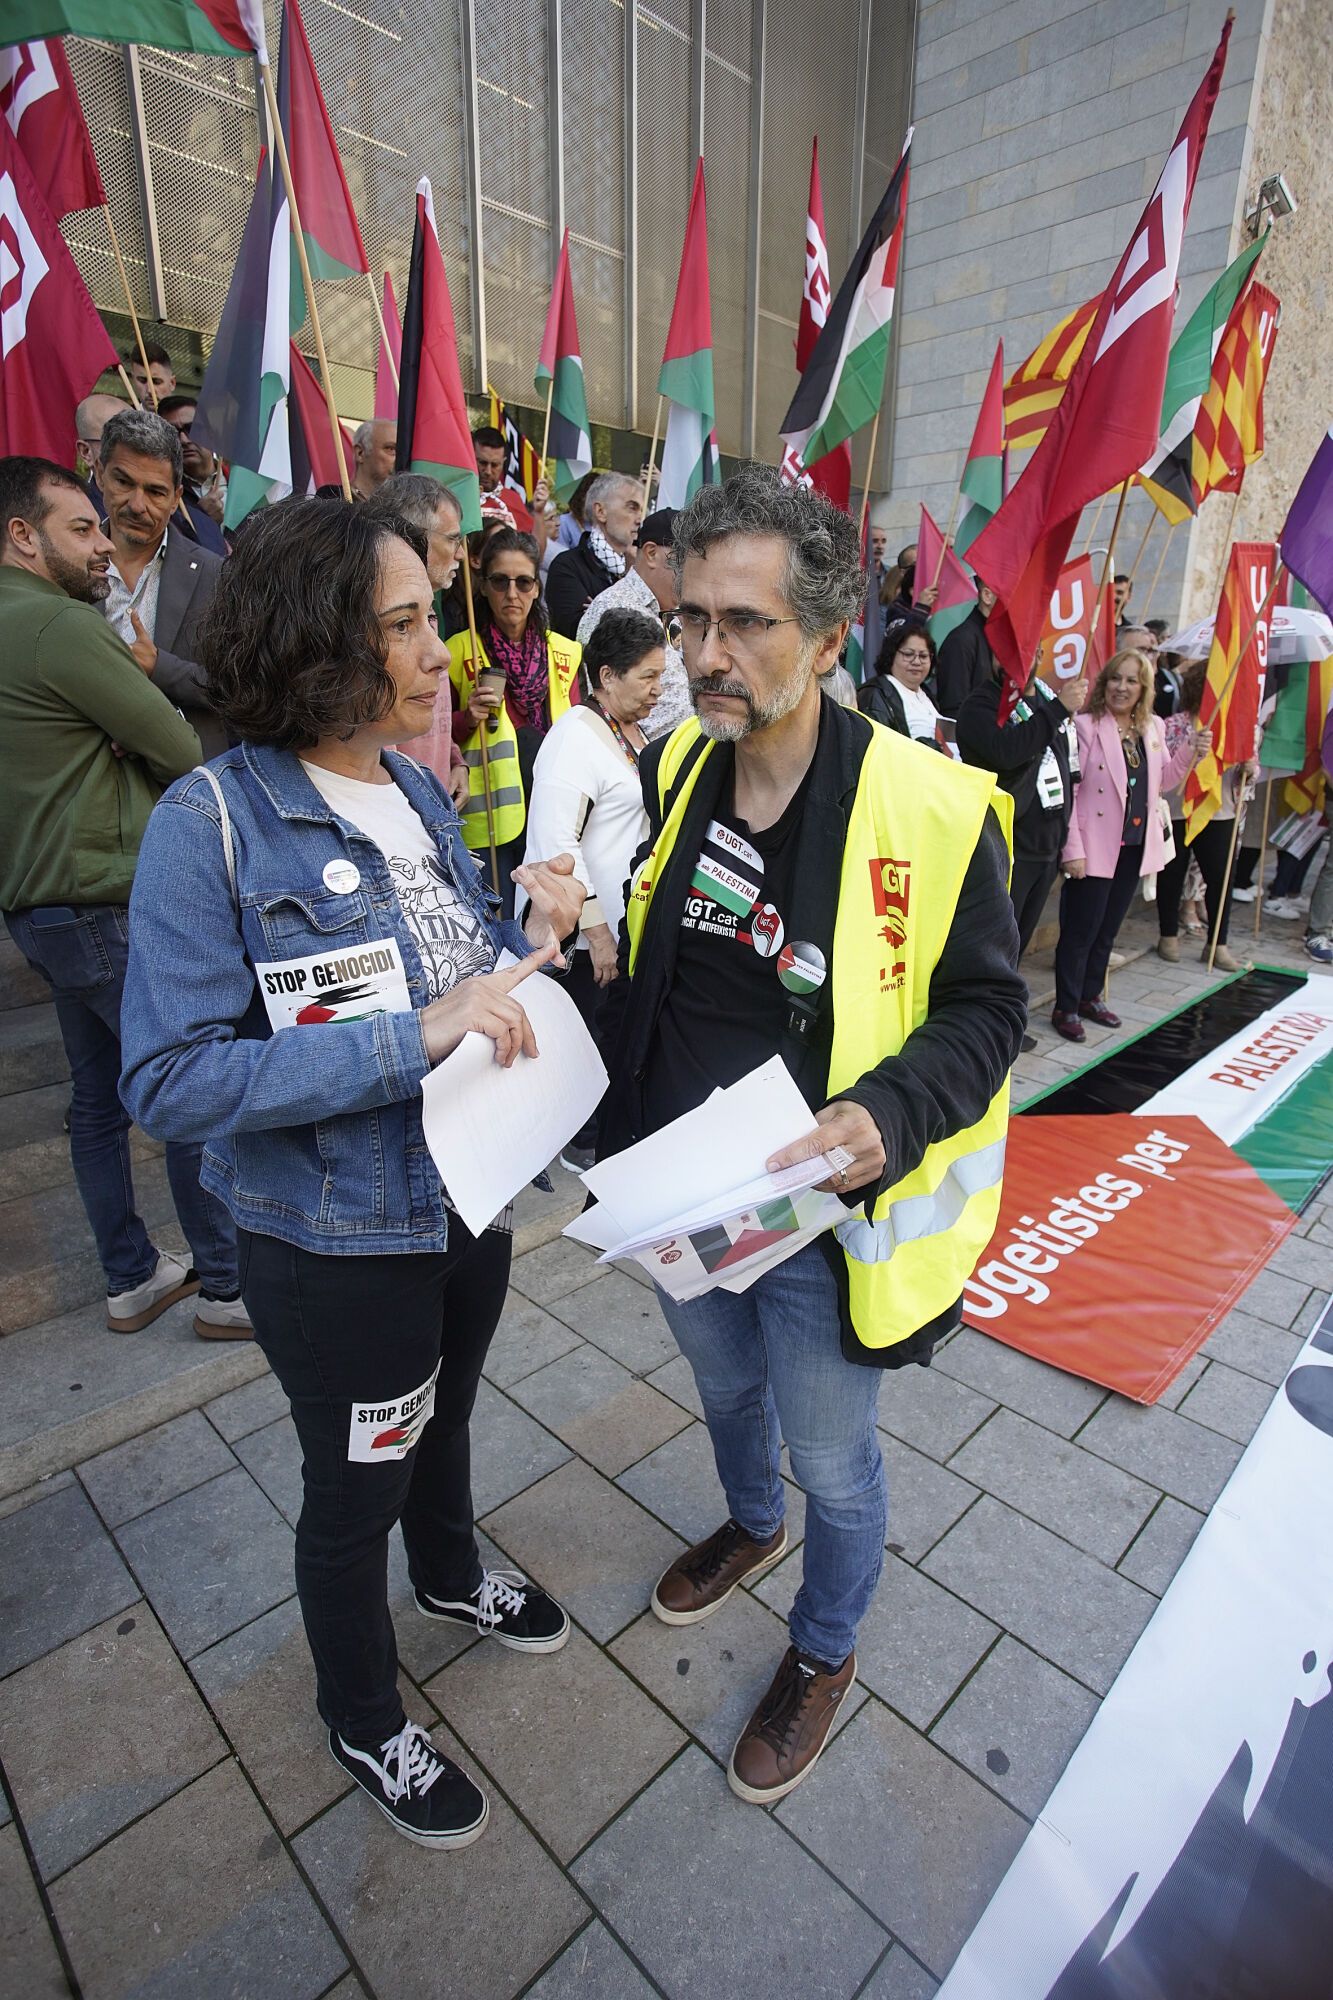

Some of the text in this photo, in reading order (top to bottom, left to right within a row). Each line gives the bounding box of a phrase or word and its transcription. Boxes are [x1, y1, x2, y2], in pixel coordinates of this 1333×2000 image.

[711, 866, 756, 900] PALESTINA
[697, 920, 737, 939] ANTIFEIXISTA
[264, 948, 396, 995] STOP GENOCIDI
[962, 1012, 1333, 1319] Ugetistes per PALESTINA
[357, 1379, 436, 1423] STOP GENOC
